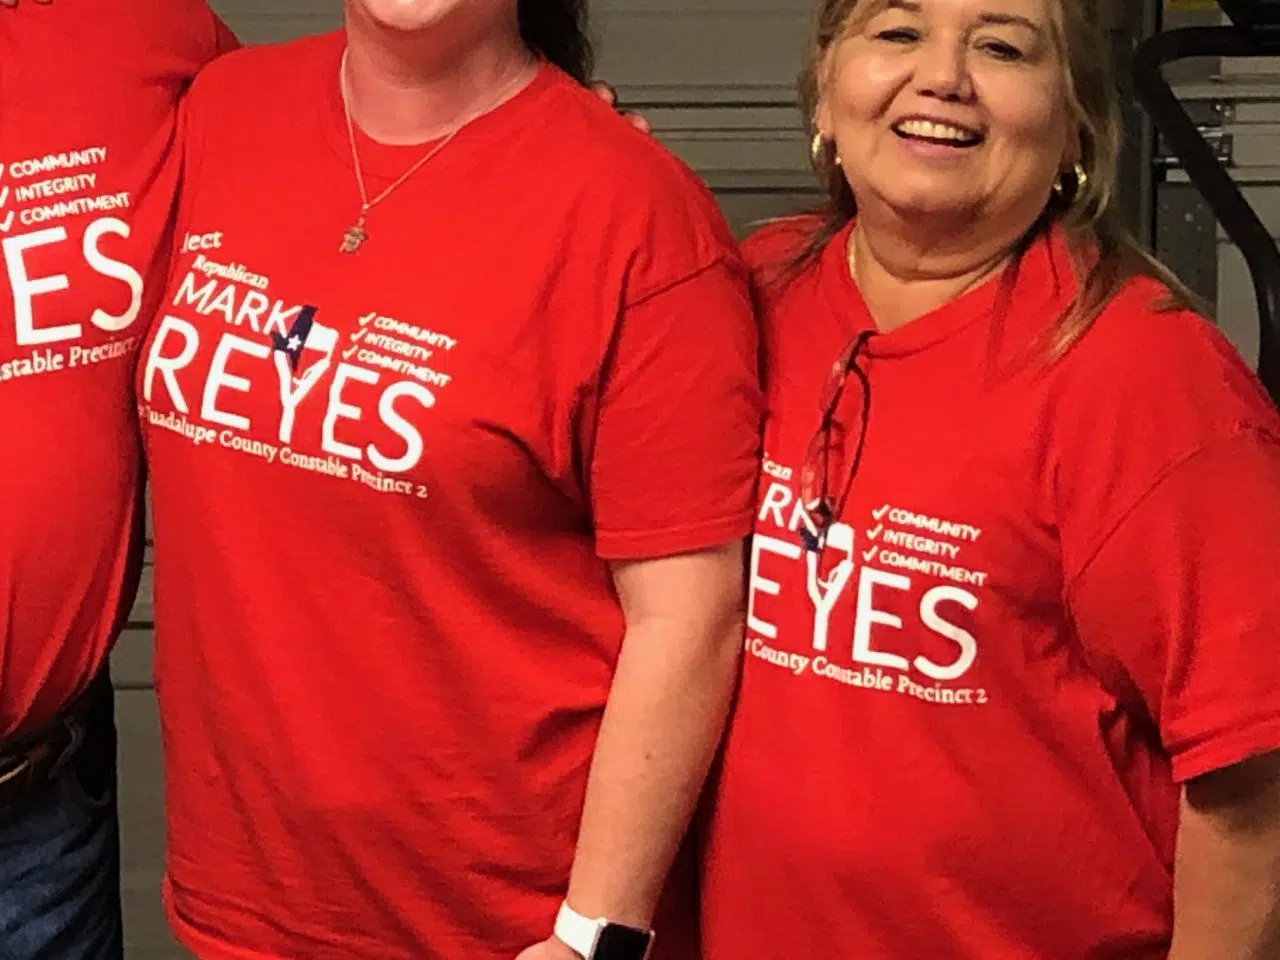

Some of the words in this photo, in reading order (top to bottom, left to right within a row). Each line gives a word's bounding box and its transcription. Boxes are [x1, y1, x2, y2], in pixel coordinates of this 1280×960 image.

[9, 147, 108, 180] COMMUNITY
[15, 173, 97, 202] INTEGRITY
[19, 192, 130, 226] COMMITMENT
[180, 231, 223, 253] lect
[192, 253, 269, 290] Republican
[173, 271, 303, 338] MARK
[363, 331, 433, 361] INTEGRITY
[373, 315, 457, 351] COMMUNITY
[357, 348, 451, 388] COMMITMENT
[143, 314, 436, 473] REYES
[219, 429, 277, 463] County
[279, 446, 348, 478] Constable
[351, 462, 412, 494] Precinct
[416, 485, 428, 498] 2
[757, 482, 820, 537] RK
[888, 508, 981, 542] COMMUNITY
[883, 530, 960, 559] INTEGRITY
[879, 548, 988, 587] COMMITMENT
[746, 533, 979, 680] EYES
[751, 638, 810, 675] County
[812, 655, 894, 691] Constable
[896, 675, 974, 703] Precinct
[976, 688, 988, 704] 2
